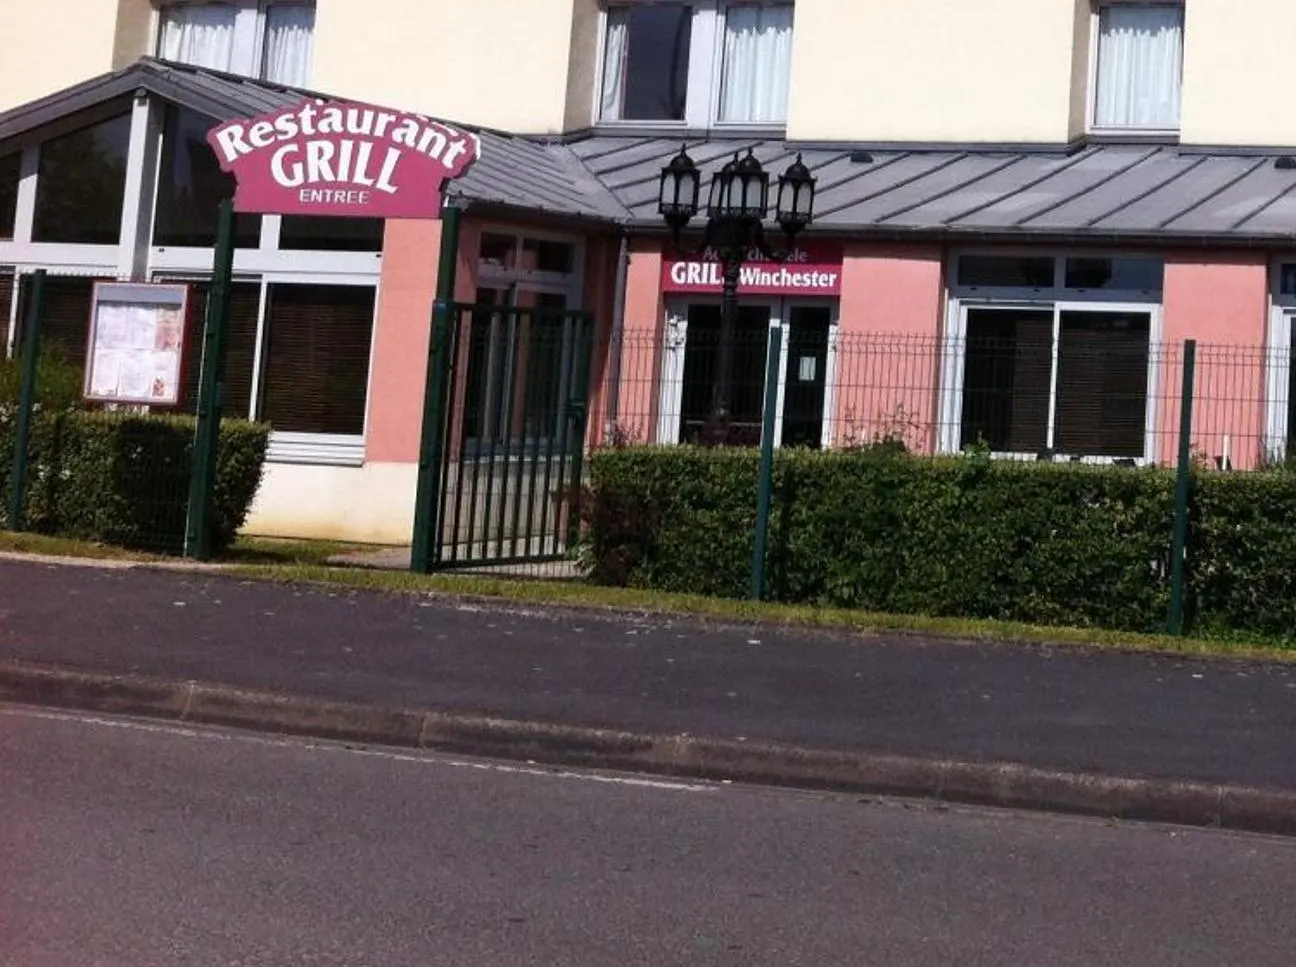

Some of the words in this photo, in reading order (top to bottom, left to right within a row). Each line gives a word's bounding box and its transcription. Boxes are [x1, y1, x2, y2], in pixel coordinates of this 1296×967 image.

[215, 99, 468, 170] Restaurant
[270, 139, 402, 194] GRILL
[671, 261, 725, 285] GRIL
[739, 267, 837, 288] Winchester
